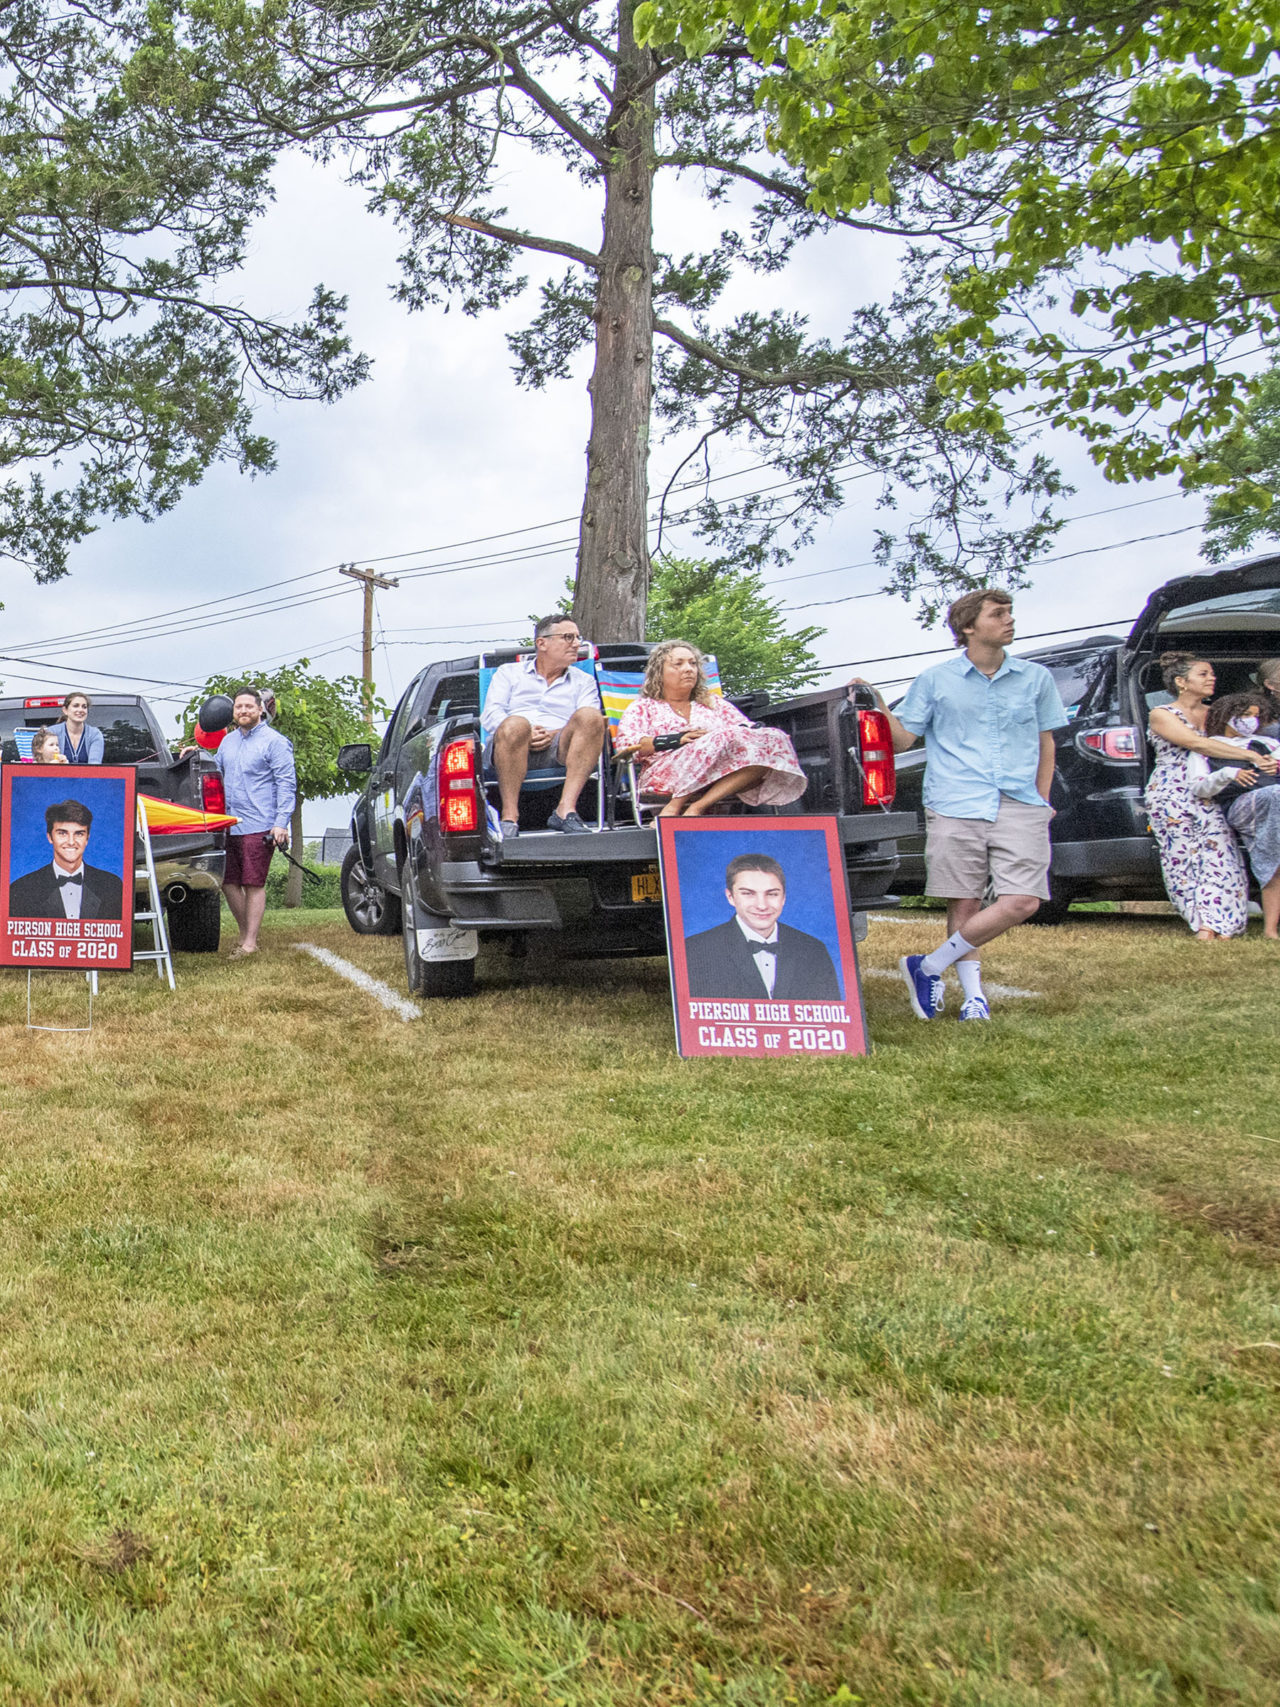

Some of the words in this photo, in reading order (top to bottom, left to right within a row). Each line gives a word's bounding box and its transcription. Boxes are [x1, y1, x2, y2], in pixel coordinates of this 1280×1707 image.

[7, 921, 52, 936] PIERSON
[55, 922, 80, 937] HIGH
[84, 923, 123, 938] SCHOOL
[12, 940, 54, 957] CLASS
[59, 946, 72, 958] OF
[77, 942, 117, 959] 2020
[688, 1002, 749, 1021] PIERSON
[754, 1003, 790, 1022] HIGH
[795, 1005, 850, 1023] SCHOOL
[698, 1026, 758, 1048] CLASS
[763, 1034, 781, 1049] OF
[788, 1029, 846, 1050] 2020
